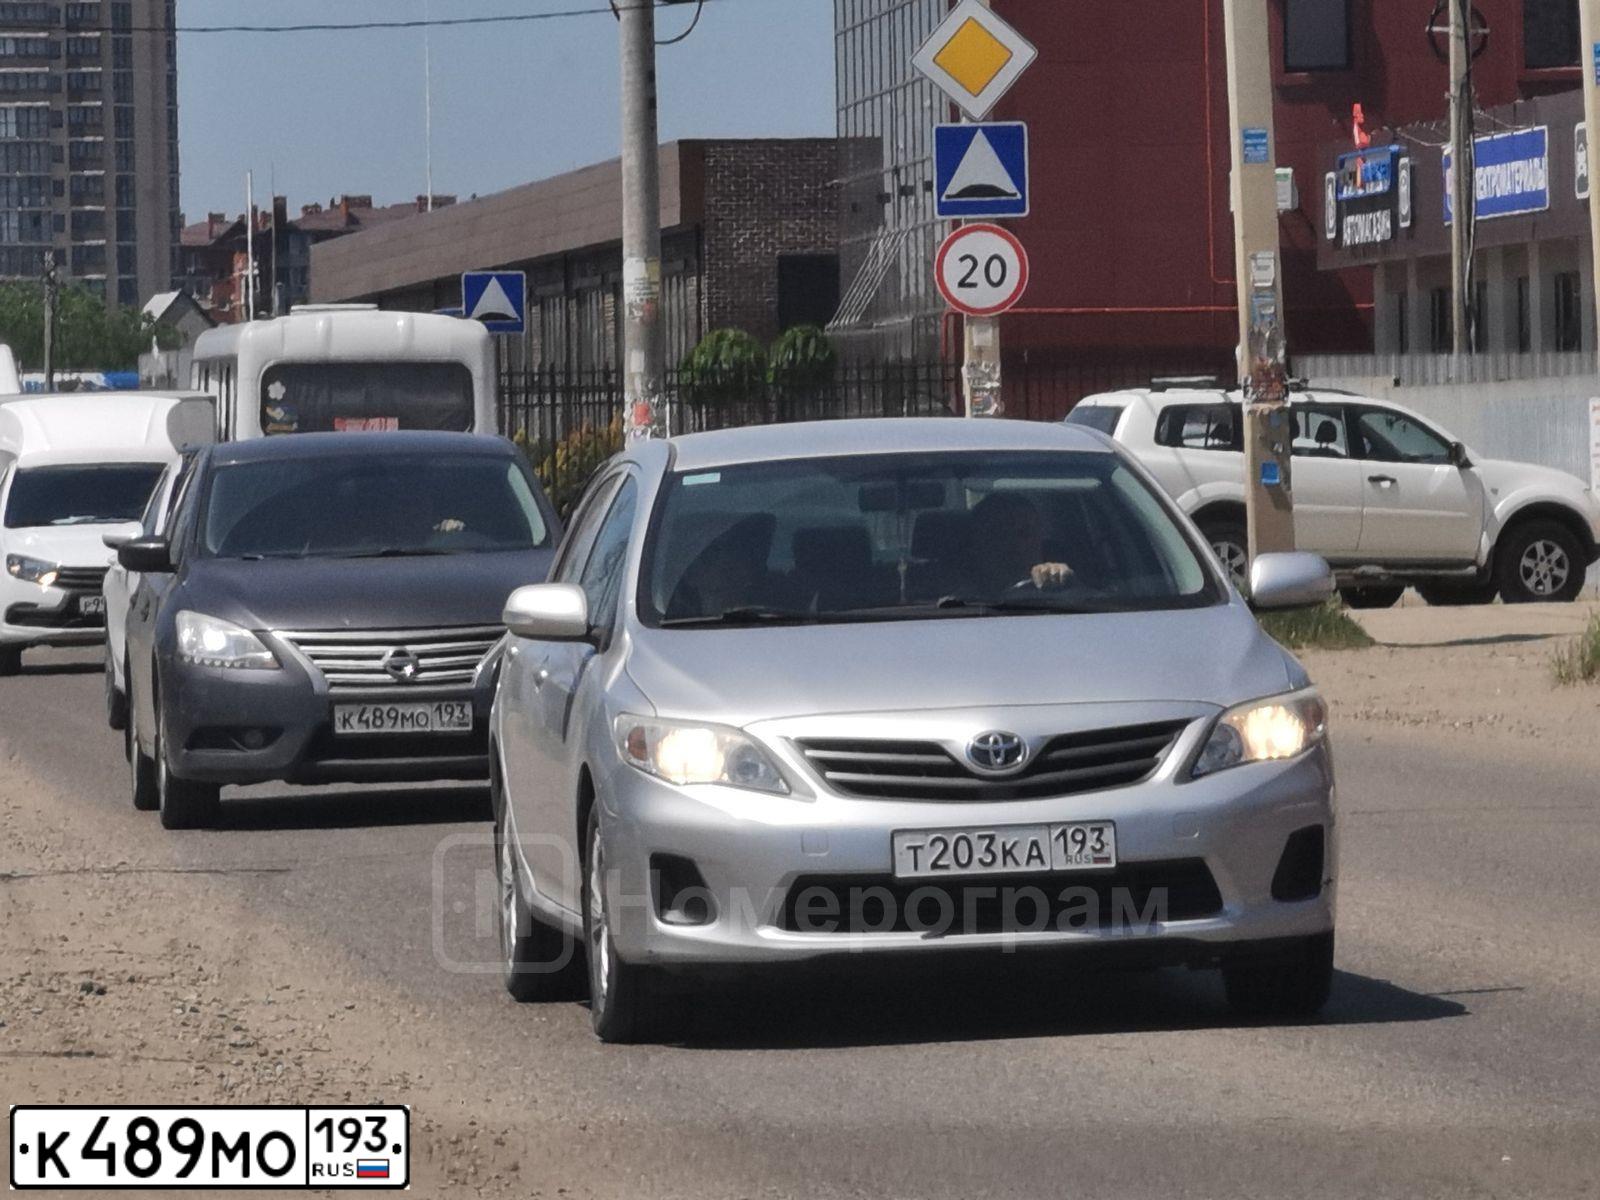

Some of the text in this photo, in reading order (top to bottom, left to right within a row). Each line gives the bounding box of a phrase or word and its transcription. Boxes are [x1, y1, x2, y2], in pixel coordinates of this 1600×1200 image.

[1475, 157, 1546, 200] ЕКТРОМАТЕРИАЛЫ
[957, 253, 1007, 288] 20
[341, 703, 466, 730] К489МО 193
[905, 826, 1106, 873] Т203КА 193
[1065, 854, 1091, 865] RUS
